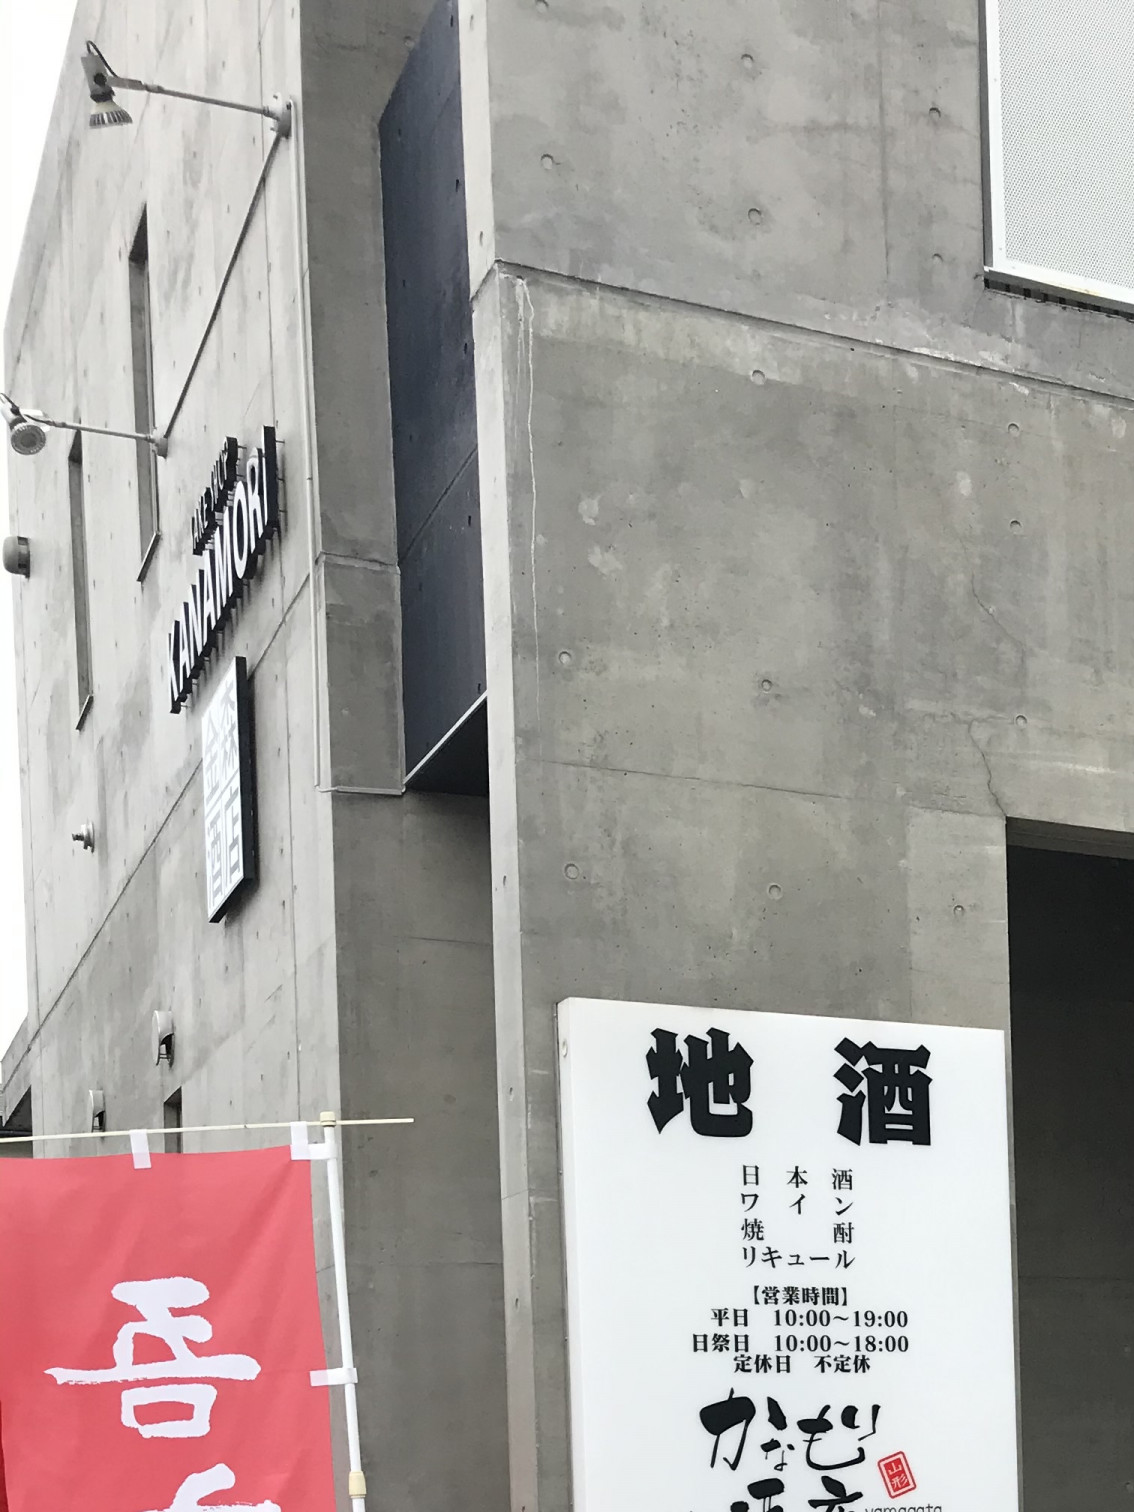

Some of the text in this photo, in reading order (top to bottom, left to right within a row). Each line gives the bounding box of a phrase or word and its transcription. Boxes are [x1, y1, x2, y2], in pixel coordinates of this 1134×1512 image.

[168, 424, 278, 714] KANAMORI
[645, 1027, 934, 1146] 地酒
[741, 1164, 854, 1191] 日本酒
[740, 1193, 854, 1216] ワイン
[740, 1218, 854, 1244] 焼酎
[742, 1246, 855, 1269] リキュール
[753, 1285, 848, 1306] 【営業時間】
[711, 1308, 909, 1328] 平日 10:00～19:00
[692, 1334, 909, 1353] 日祭日 10:00～18:00
[733, 1355, 871, 1374] 定休日 不定休
[699, 1387, 881, 1471] かなもり
[887, 1460, 909, 1491] 山形
